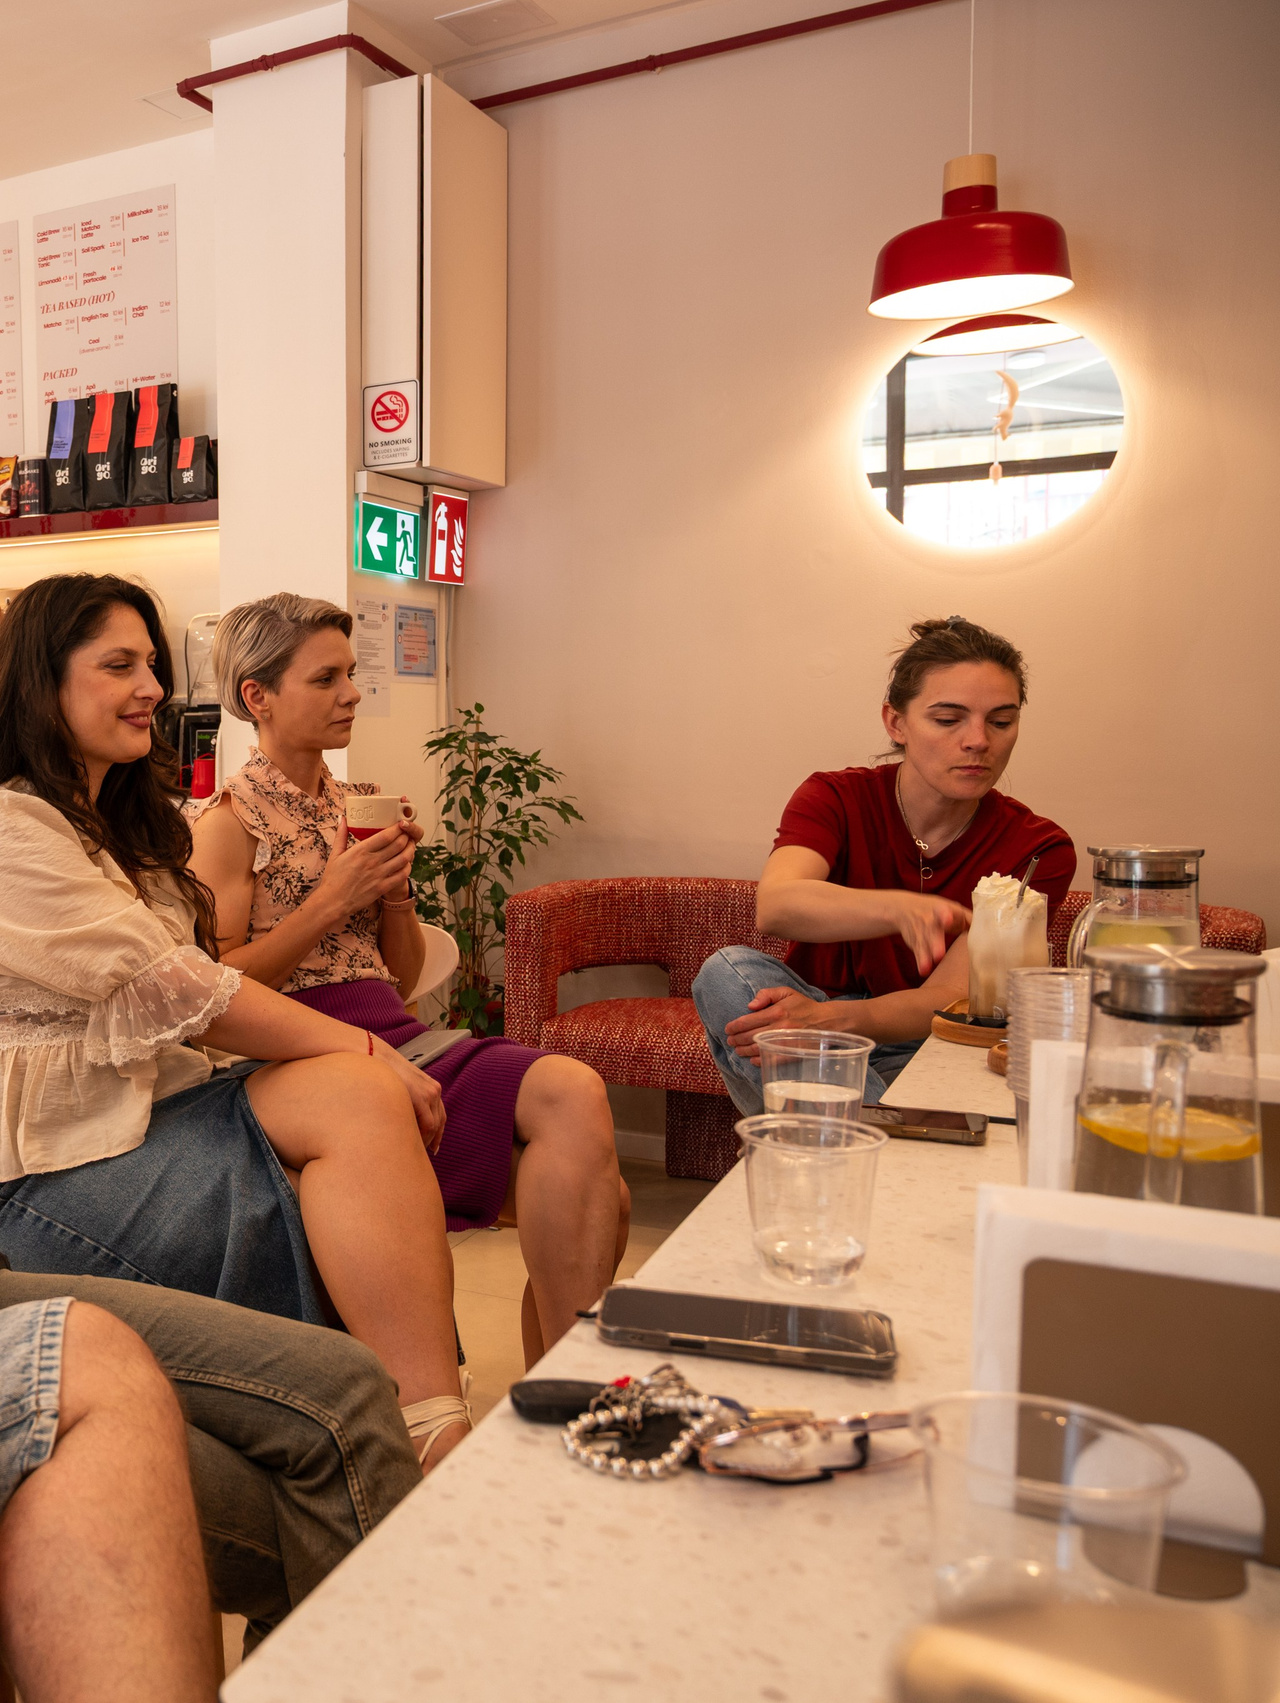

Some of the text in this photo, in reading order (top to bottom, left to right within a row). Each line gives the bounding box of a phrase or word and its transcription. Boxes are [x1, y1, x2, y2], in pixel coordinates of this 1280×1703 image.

[127, 208, 153, 218] Milkshake
[37, 230, 48, 238] Cold
[91, 244, 105, 253] Spark
[83, 275, 106, 285] portocale
[40, 291, 115, 314] TEA BASED (HOT)
[82, 314, 100, 322] English
[43, 367, 78, 380] PACKED
[380, 438, 412, 447] SMOKING
